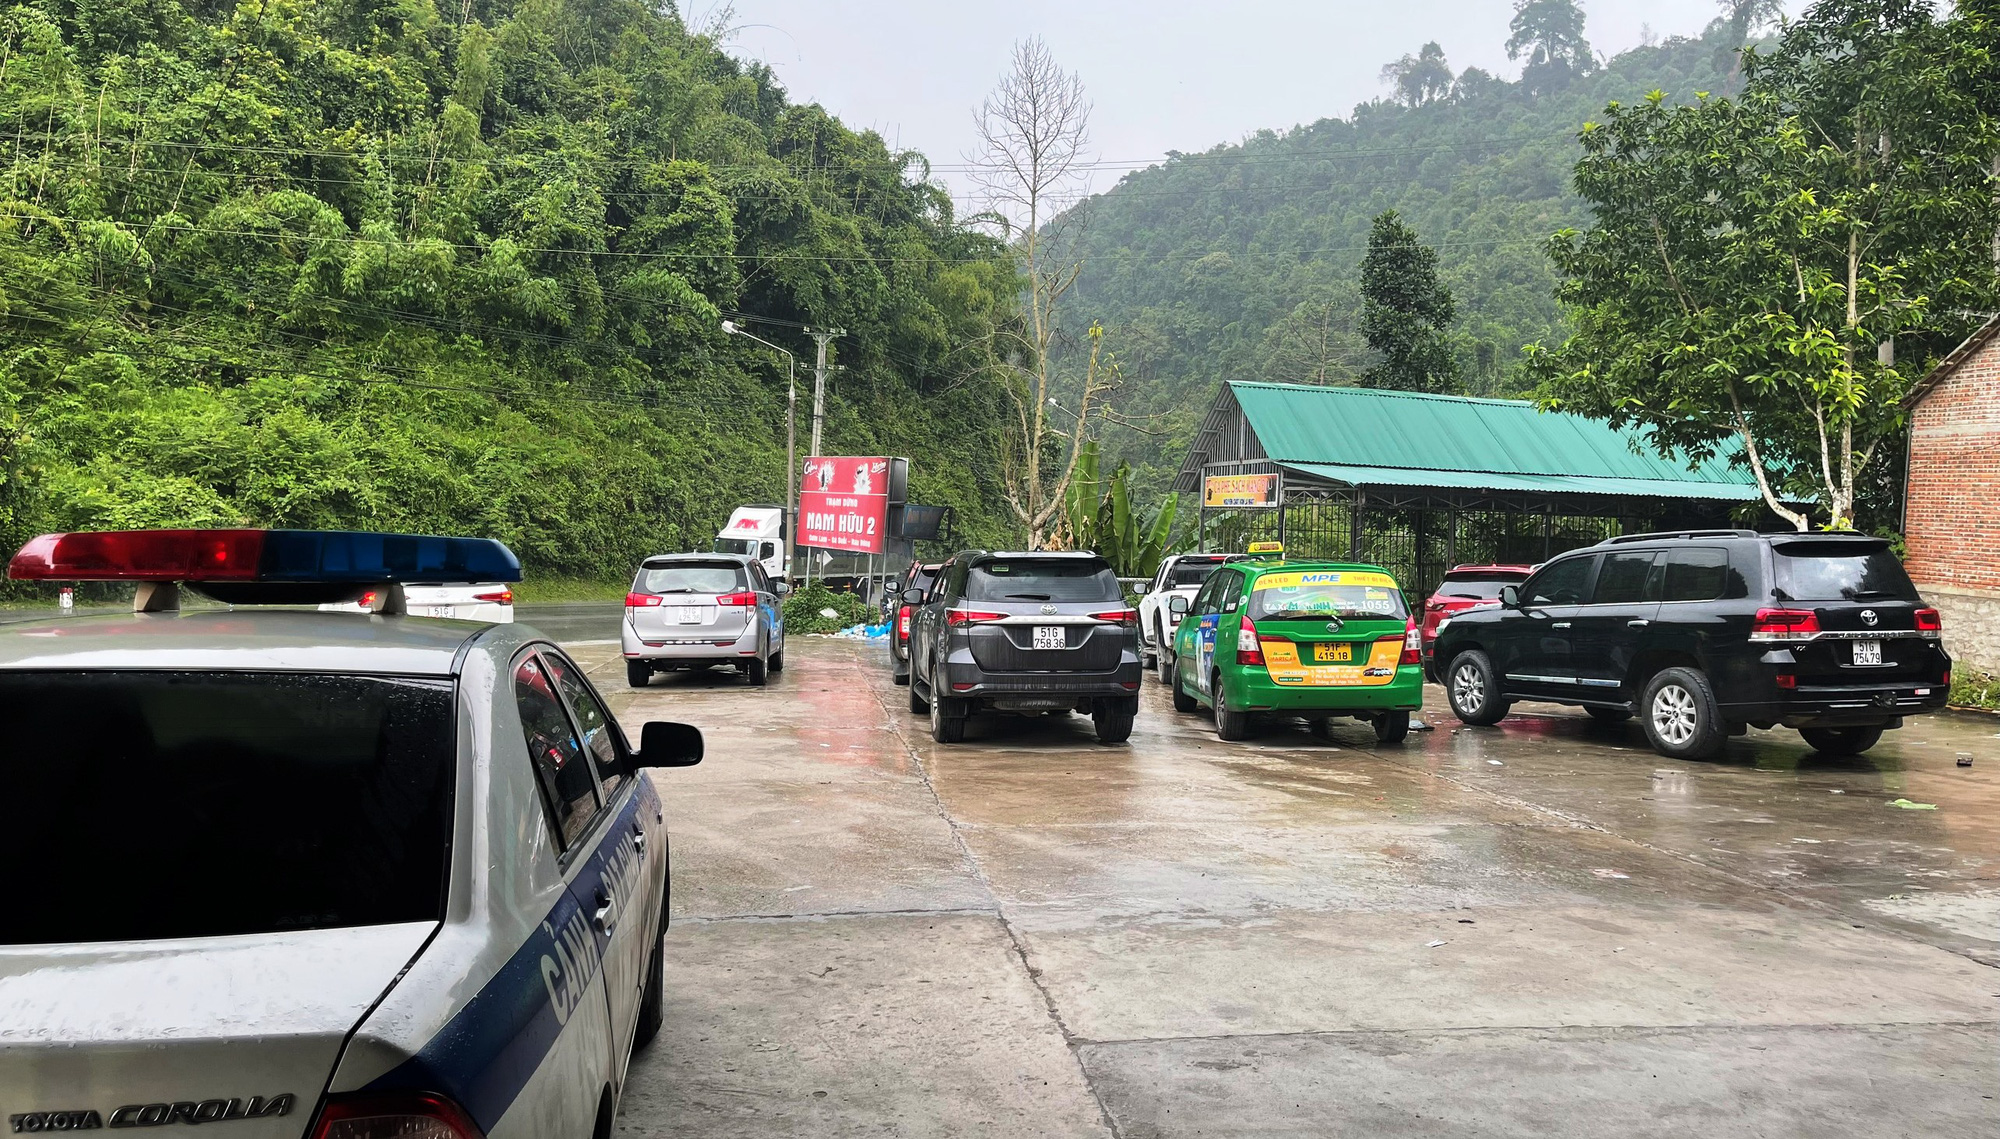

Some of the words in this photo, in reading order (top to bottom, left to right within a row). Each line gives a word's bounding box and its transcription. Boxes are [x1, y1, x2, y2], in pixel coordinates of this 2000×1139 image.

[806, 512, 835, 532] NAM
[838, 511, 864, 535] HỮU
[866, 517, 876, 535] 2
[1301, 574, 1341, 583] MPE
[1361, 600, 1390, 610] 1055
[1040, 627, 1058, 638] 51G
[1324, 643, 1341, 652] 51F
[1859, 641, 1875, 652] 51G
[540, 907, 600, 1026] CẢNH
[10, 1109, 104, 1134] TOYOTA
[107, 1092, 295, 1129] COROLLA
